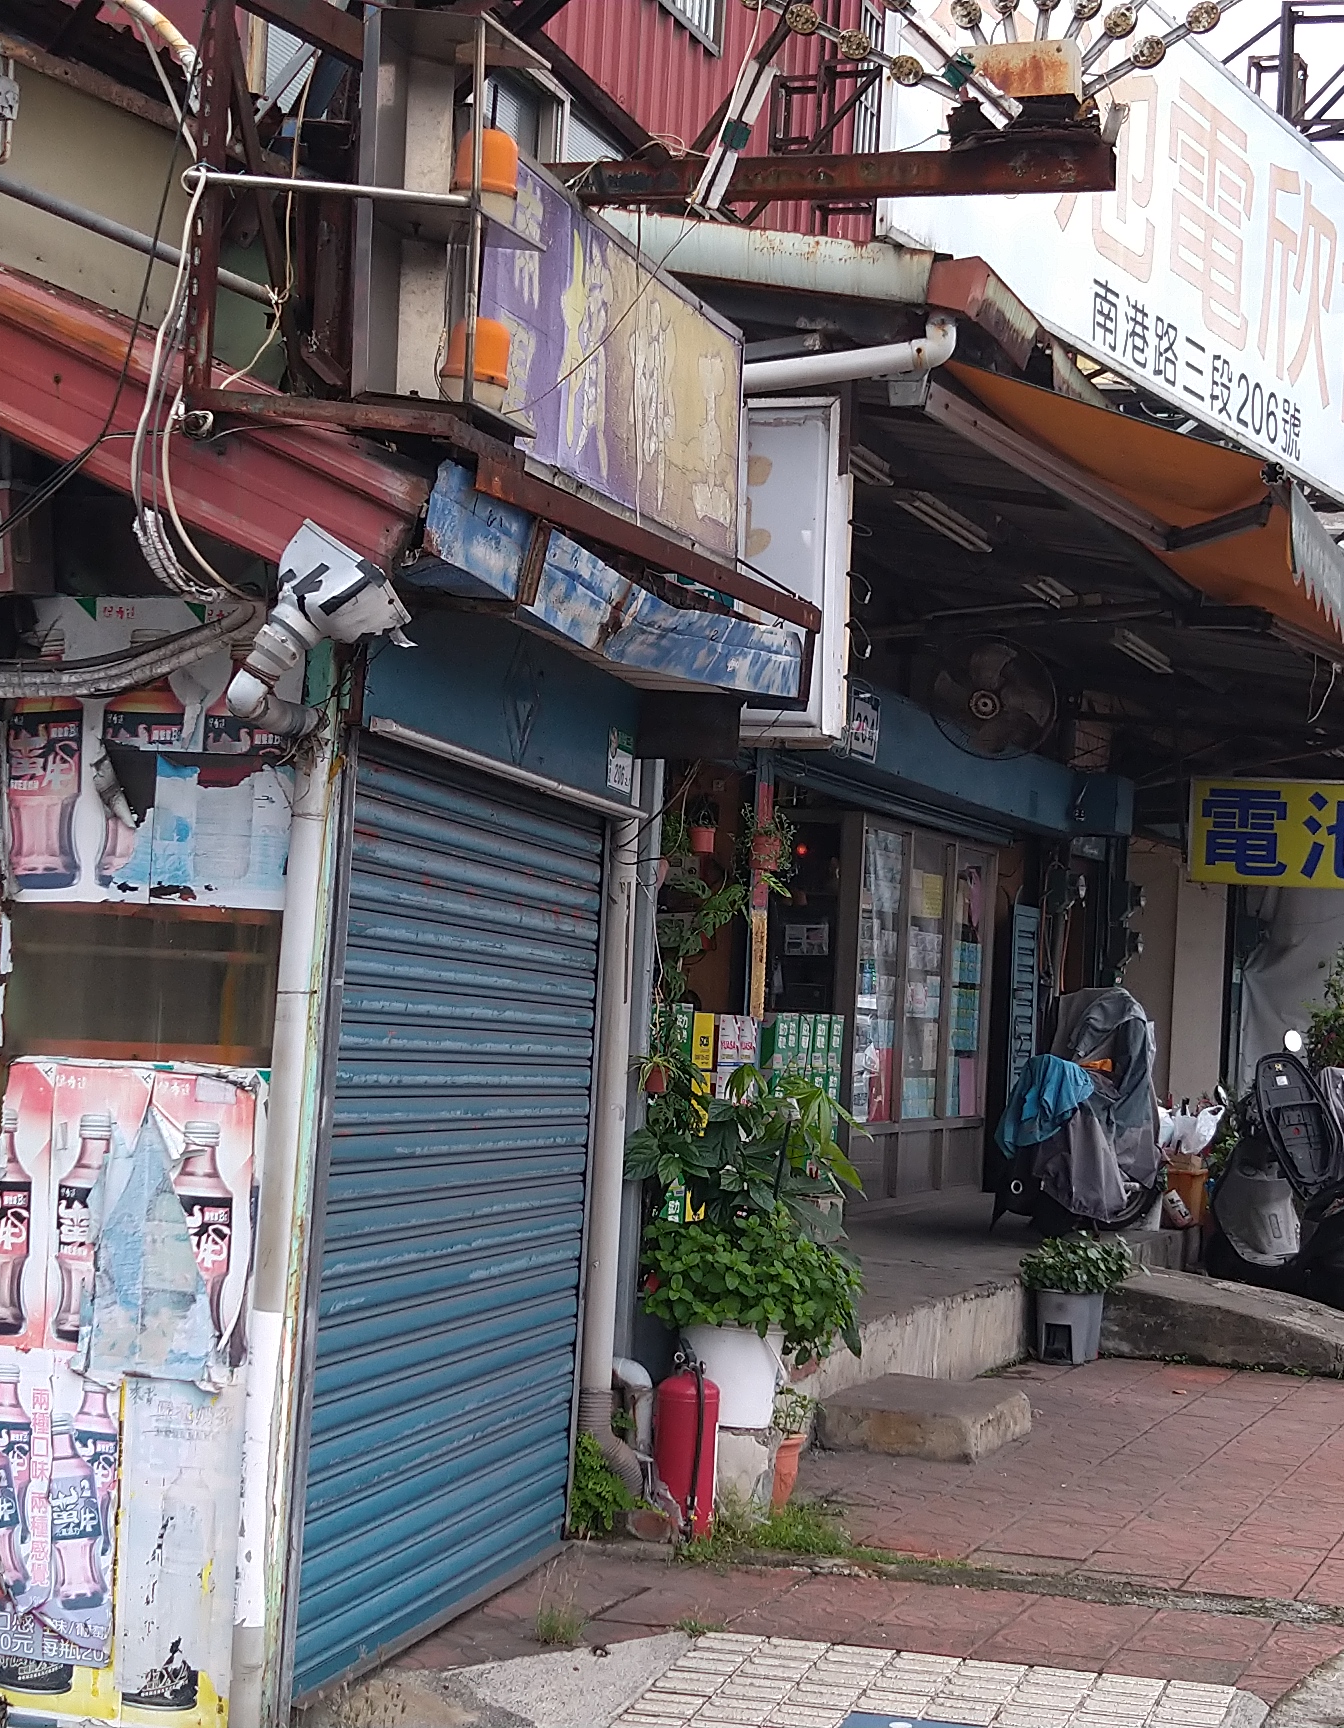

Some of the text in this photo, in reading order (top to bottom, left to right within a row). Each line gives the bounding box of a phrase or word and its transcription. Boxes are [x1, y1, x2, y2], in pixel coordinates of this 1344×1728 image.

[1090, 278, 1302, 461] 南港路三段206號
